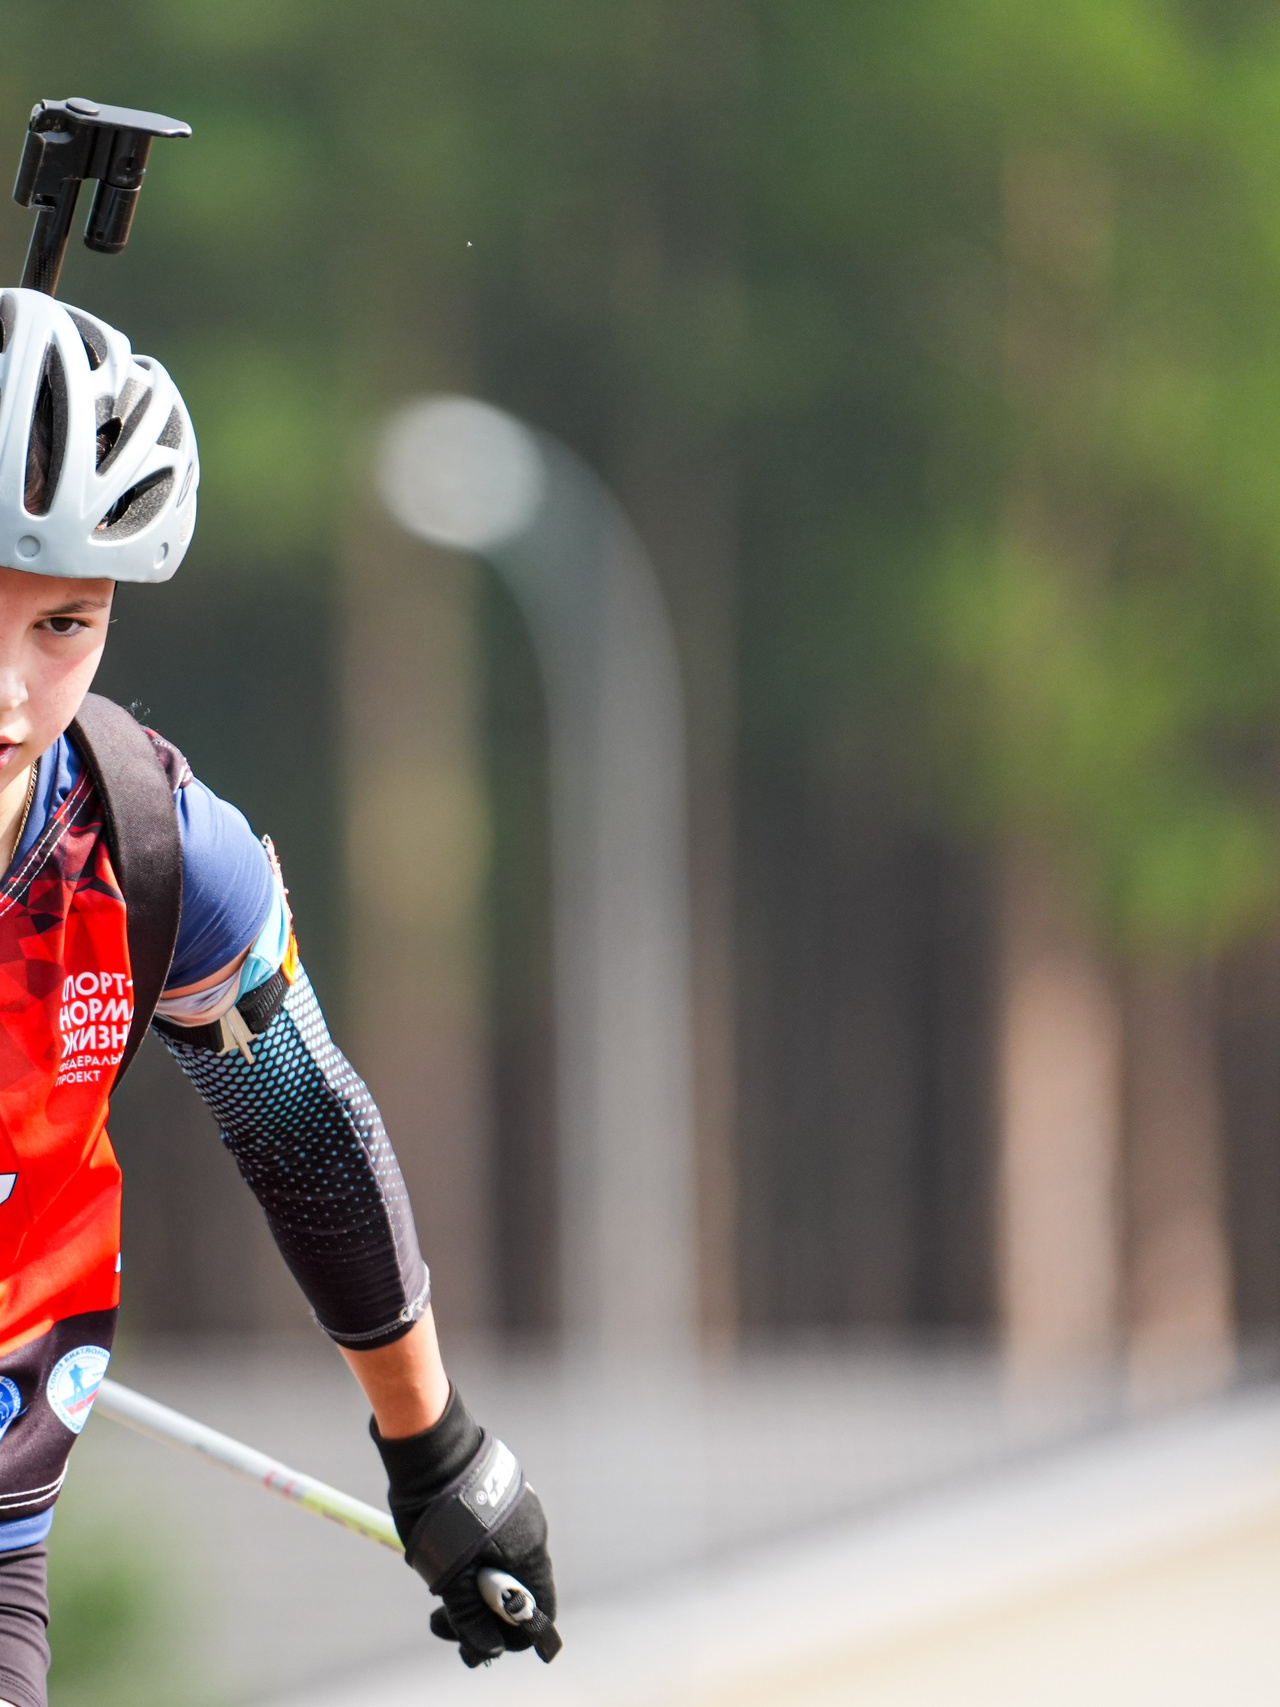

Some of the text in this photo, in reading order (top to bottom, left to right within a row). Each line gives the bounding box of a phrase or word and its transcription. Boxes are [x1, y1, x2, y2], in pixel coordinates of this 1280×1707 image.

[62, 971, 133, 1002] ПОРТ-
[59, 997, 134, 1032] НОРМ
[61, 1022, 131, 1059] ЖИЗН
[55, 1070, 100, 1087] ПРОЕКТ
